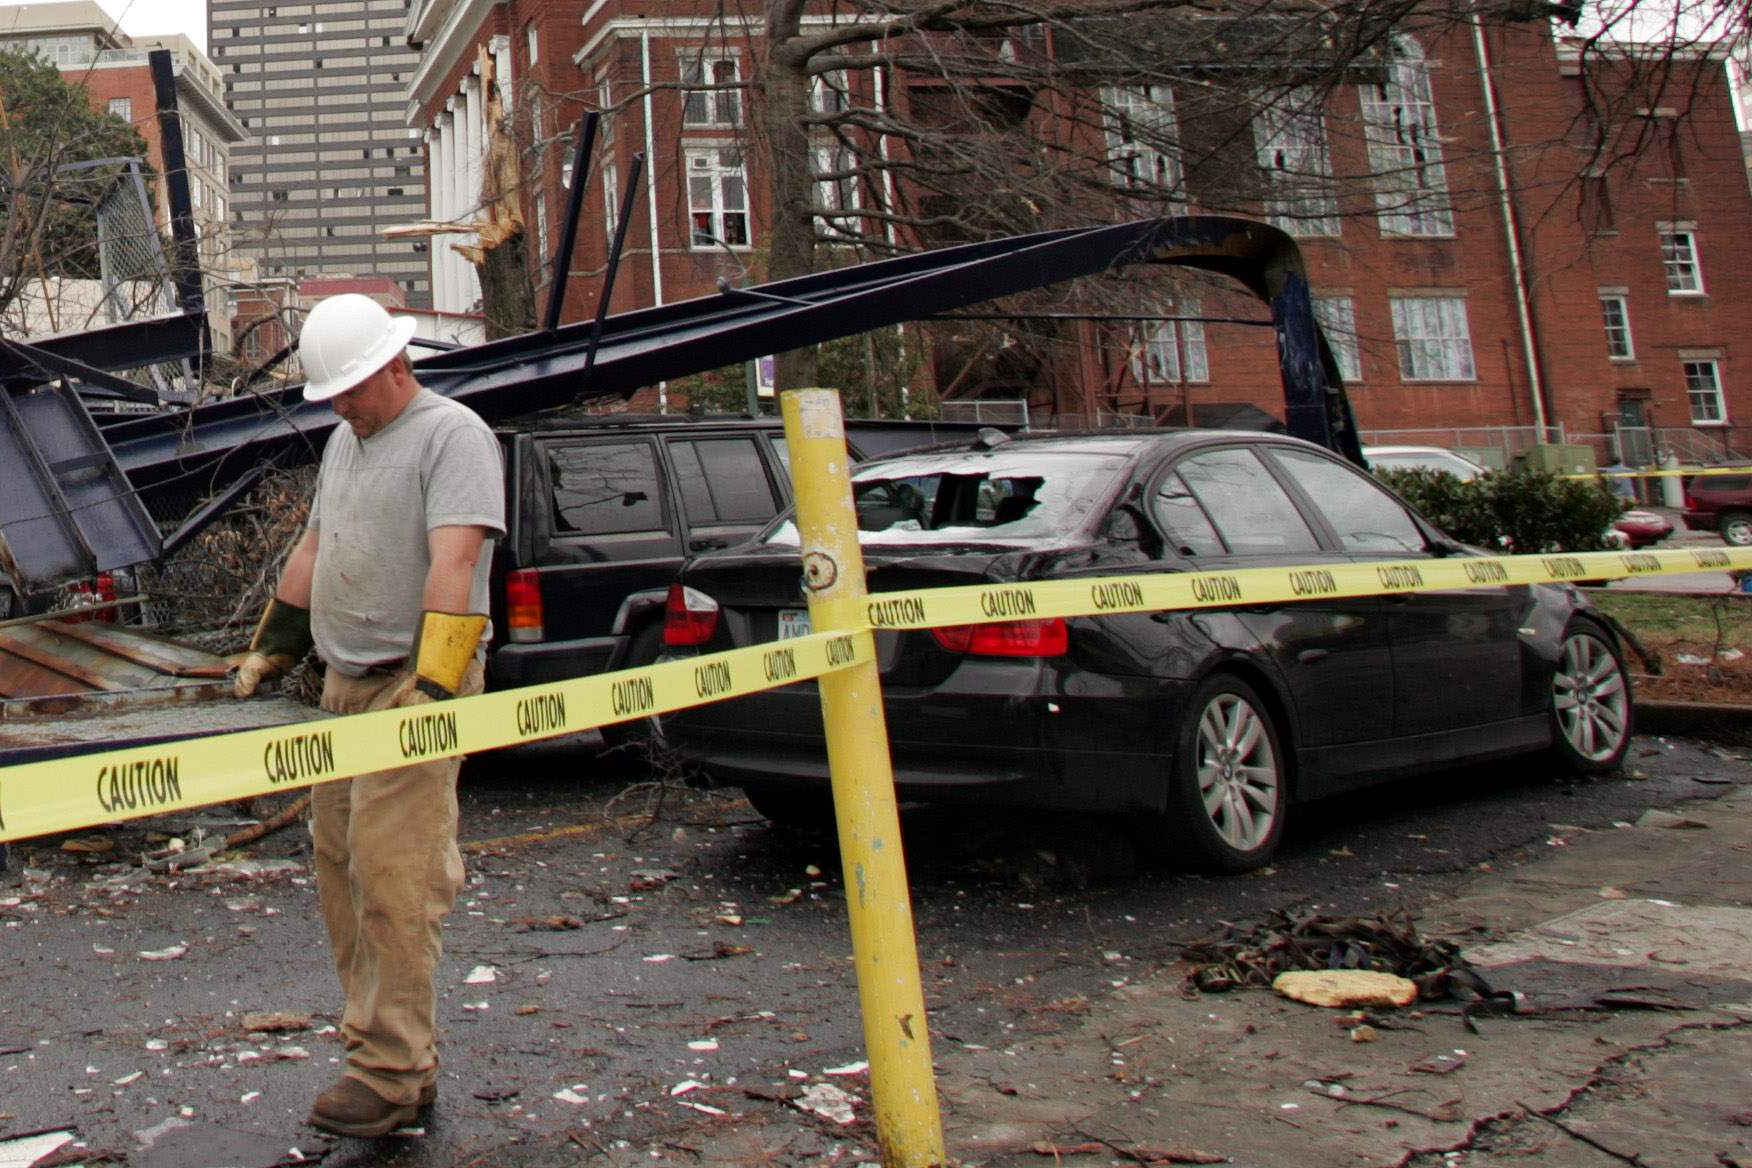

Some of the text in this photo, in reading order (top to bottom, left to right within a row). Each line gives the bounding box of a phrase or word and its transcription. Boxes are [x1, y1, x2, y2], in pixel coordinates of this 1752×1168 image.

[868, 598, 926, 628] CAUTION
[981, 590, 1035, 617] CAUTION
[1092, 584, 1144, 609] CAUTION
[1192, 577, 1241, 602] CAUTION
[1289, 571, 1336, 595] CAUTION
[1378, 566, 1424, 589] CAUTION
[1463, 561, 1508, 584] CAUTION
[1542, 558, 1586, 579] CAUTION
[97, 757, 181, 813] CAUTION
[264, 732, 334, 785] CAUTION
[399, 712, 457, 759] CAUTION
[518, 693, 565, 737] CAUTION
[612, 678, 654, 717] CAUTION
[696, 661, 732, 698] CAUTION
[765, 648, 797, 682] CAUTION
[826, 635, 855, 667] CAUTION
